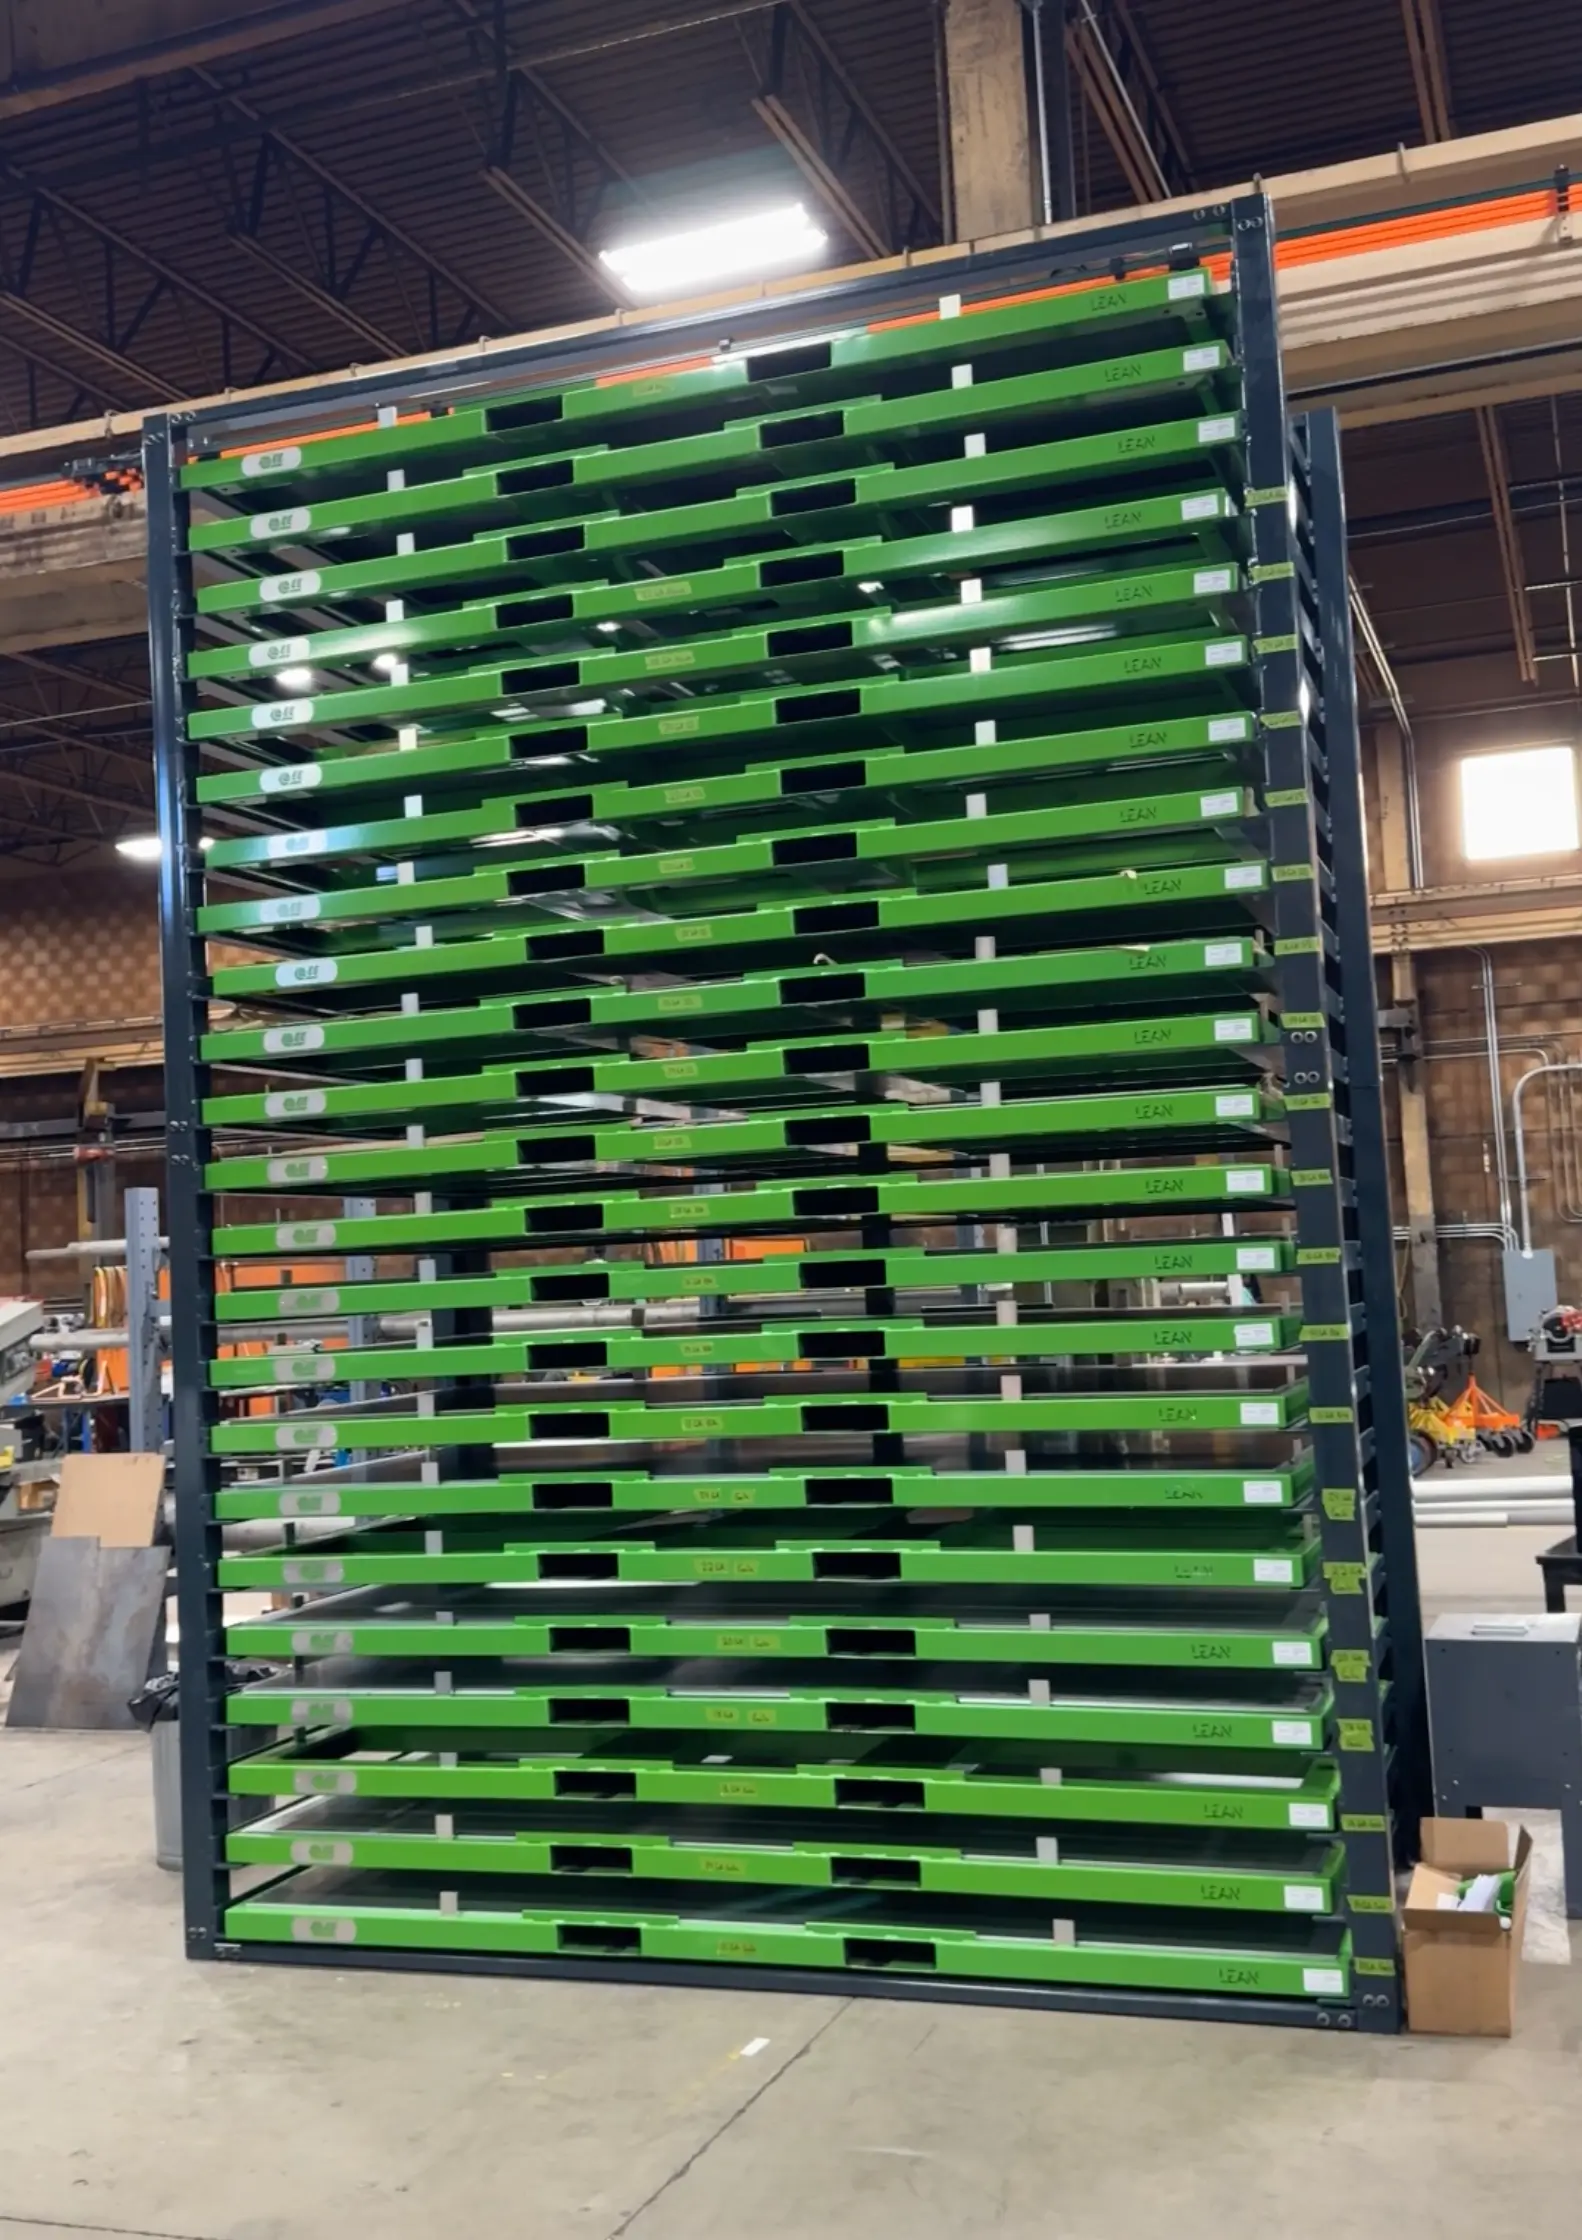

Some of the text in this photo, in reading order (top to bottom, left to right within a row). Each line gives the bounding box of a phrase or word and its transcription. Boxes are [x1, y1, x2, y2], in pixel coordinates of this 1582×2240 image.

[1090, 293, 1127, 311] LEAN
[1105, 364, 1142, 382] LEAN
[1117, 435, 1156, 454] LEAN
[1105, 511, 1142, 529] LEAN
[1116, 585, 1153, 603] LEAN
[1124, 656, 1162, 673] LEAN
[1129, 732, 1167, 748] LEAN
[1120, 807, 1158, 823] LEAN
[1144, 879, 1181, 896] LEAN
[1129, 955, 1166, 971] LEAN
[1134, 1029, 1171, 1044] LEAN
[1135, 1104, 1173, 1119] LEAN
[1146, 1179, 1184, 1194] LEAN
[1155, 1255, 1193, 1270] LEAN
[1154, 1331, 1192, 1345] LEAN
[1158, 1408, 1197, 1422] LEAN
[1192, 1645, 1231, 1659] LEAN
[1192, 1724, 1232, 1739] LEAN
[1204, 1804, 1243, 1819] LEAN
[1201, 1885, 1241, 1900] LEAN
[1219, 1968, 1259, 1984] LEAN
